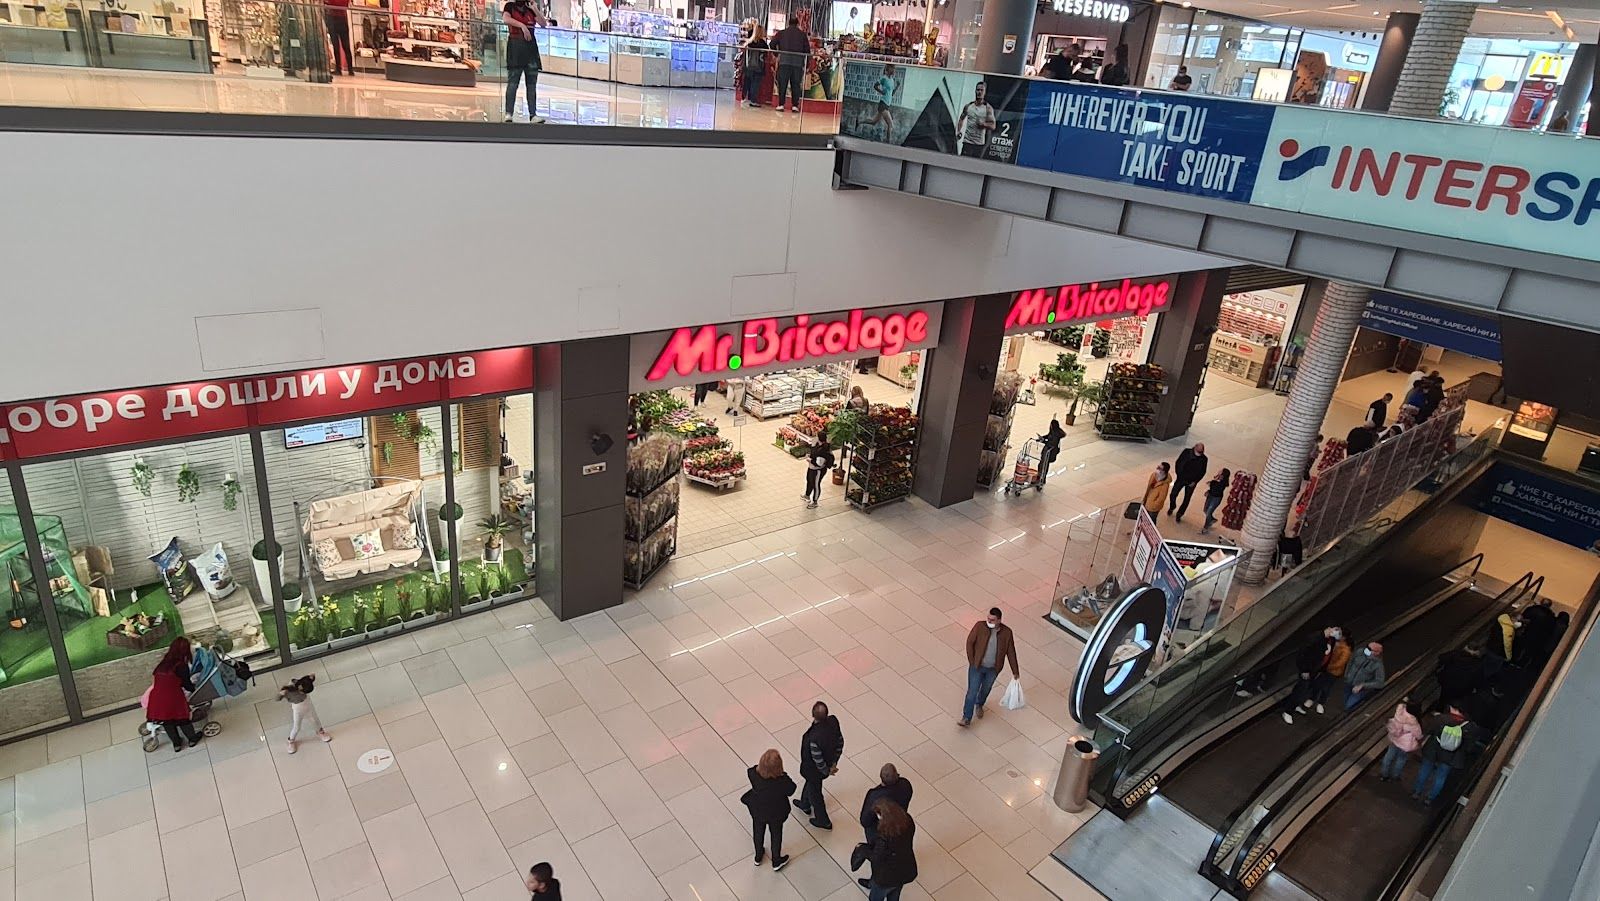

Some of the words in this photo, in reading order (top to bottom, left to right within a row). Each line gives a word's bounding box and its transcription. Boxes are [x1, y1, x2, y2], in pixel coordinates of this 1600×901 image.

[1053, 0, 1130, 23] RESERVED
[1000, 123, 1010, 137] 2
[1048, 91, 1148, 136] WHEREVER
[1156, 102, 1208, 145] YOU
[991, 136, 1014, 146] етаж
[1119, 140, 1173, 182] TAKE
[1176, 148, 1246, 193] SPORT
[0, 393, 146, 443] обре
[162, 371, 327, 421] дошли
[337, 368, 362, 399] у
[373, 355, 476, 394] дома
[1516, 490, 1561, 511] ХАРЕСАЙ
[1563, 509, 1578, 519] НИ
[1519, 484, 1540, 496] НИЕ
[1542, 490, 1553, 500] ТЕ
